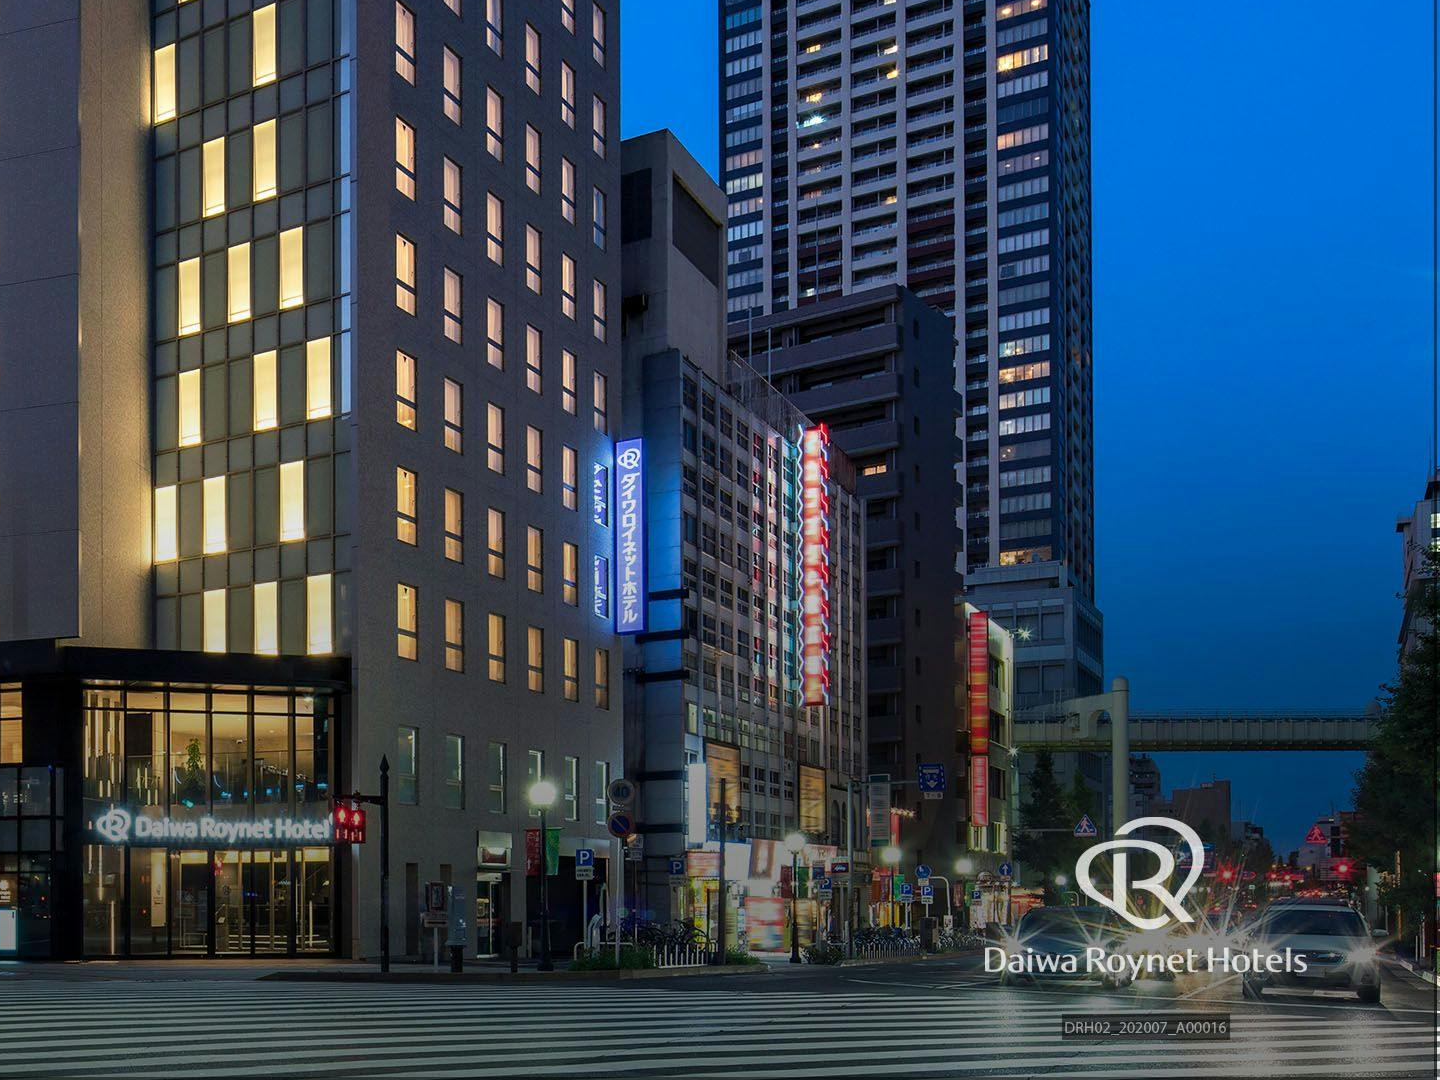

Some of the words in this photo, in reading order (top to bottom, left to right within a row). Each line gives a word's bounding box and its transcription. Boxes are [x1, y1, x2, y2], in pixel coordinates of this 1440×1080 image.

[621, 471, 641, 624] ダイワロイネットホテル
[135, 816, 201, 838] Daiwa
[200, 817, 274, 843] Roynet
[275, 816, 330, 839] Hotel
[579, 850, 590, 865] P
